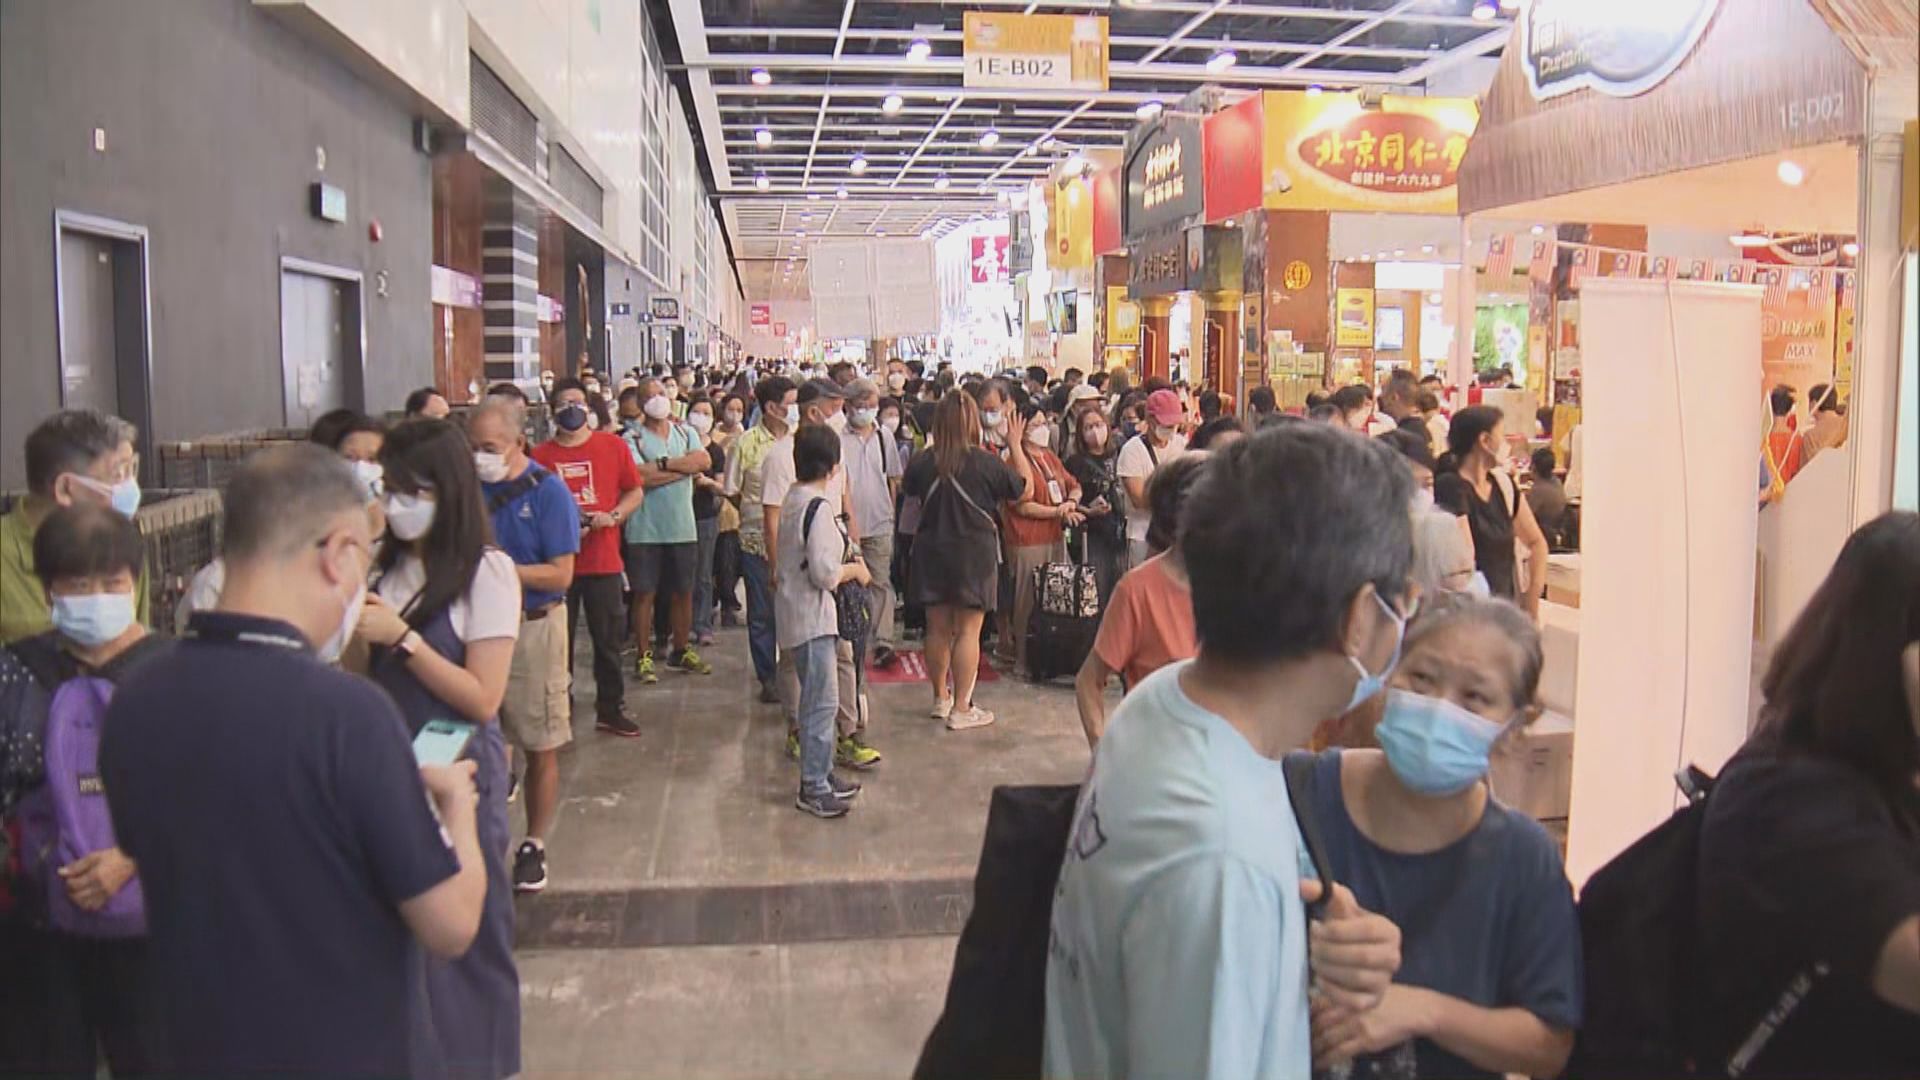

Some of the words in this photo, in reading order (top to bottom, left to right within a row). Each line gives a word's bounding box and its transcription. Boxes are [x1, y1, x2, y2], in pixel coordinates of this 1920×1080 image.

[976, 57, 1054, 77] 1E-B02
[1780, 92, 1844, 129] 1E-D02
[1786, 344, 1816, 358] MAX
